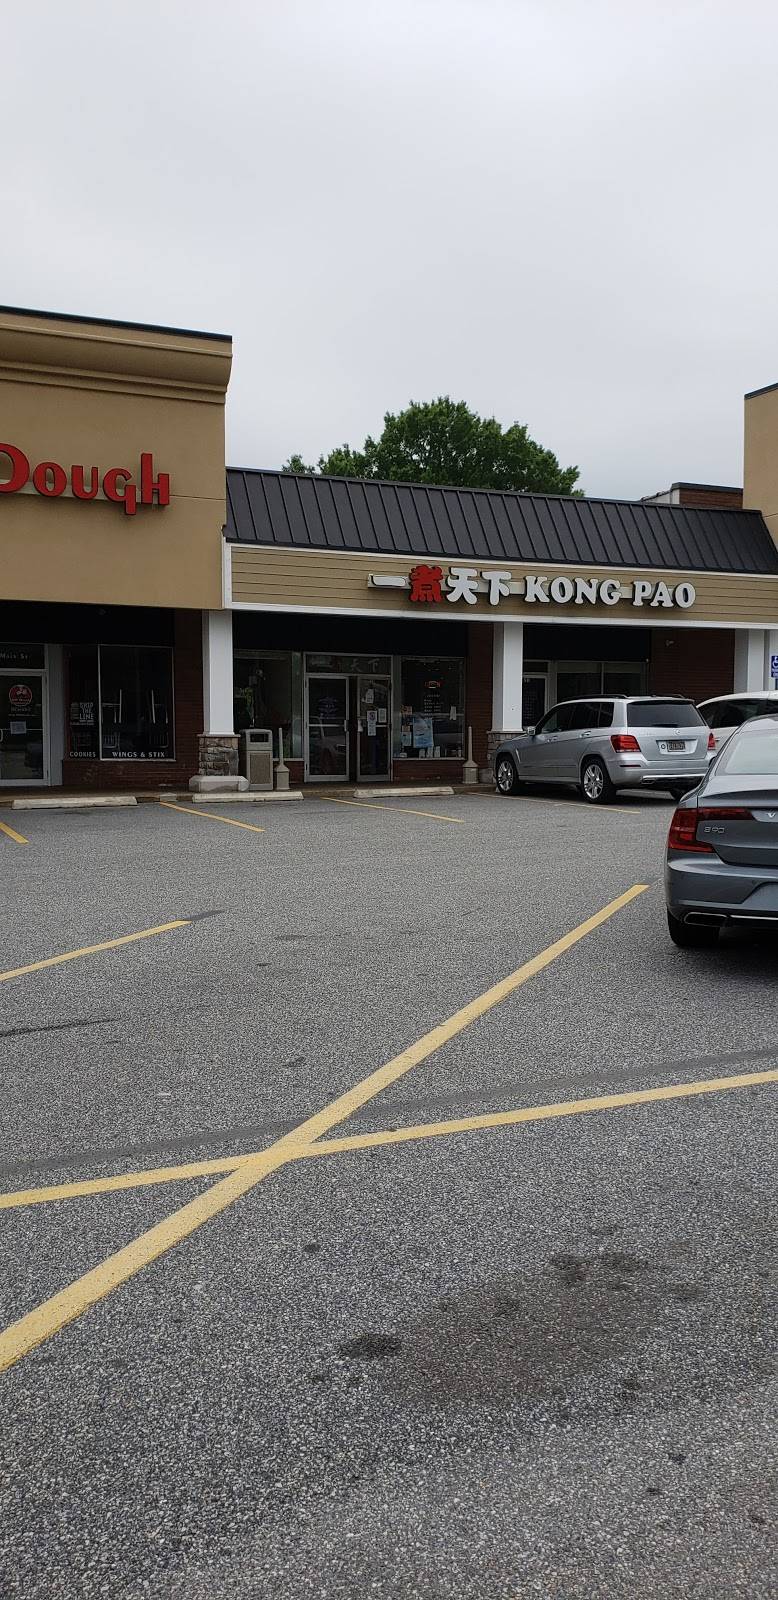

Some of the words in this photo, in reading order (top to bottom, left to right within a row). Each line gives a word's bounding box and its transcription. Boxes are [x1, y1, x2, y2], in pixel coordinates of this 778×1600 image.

[0, 443, 170, 515] Dough
[524, 575, 622, 605] KONG
[632, 580, 696, 608] PAO
